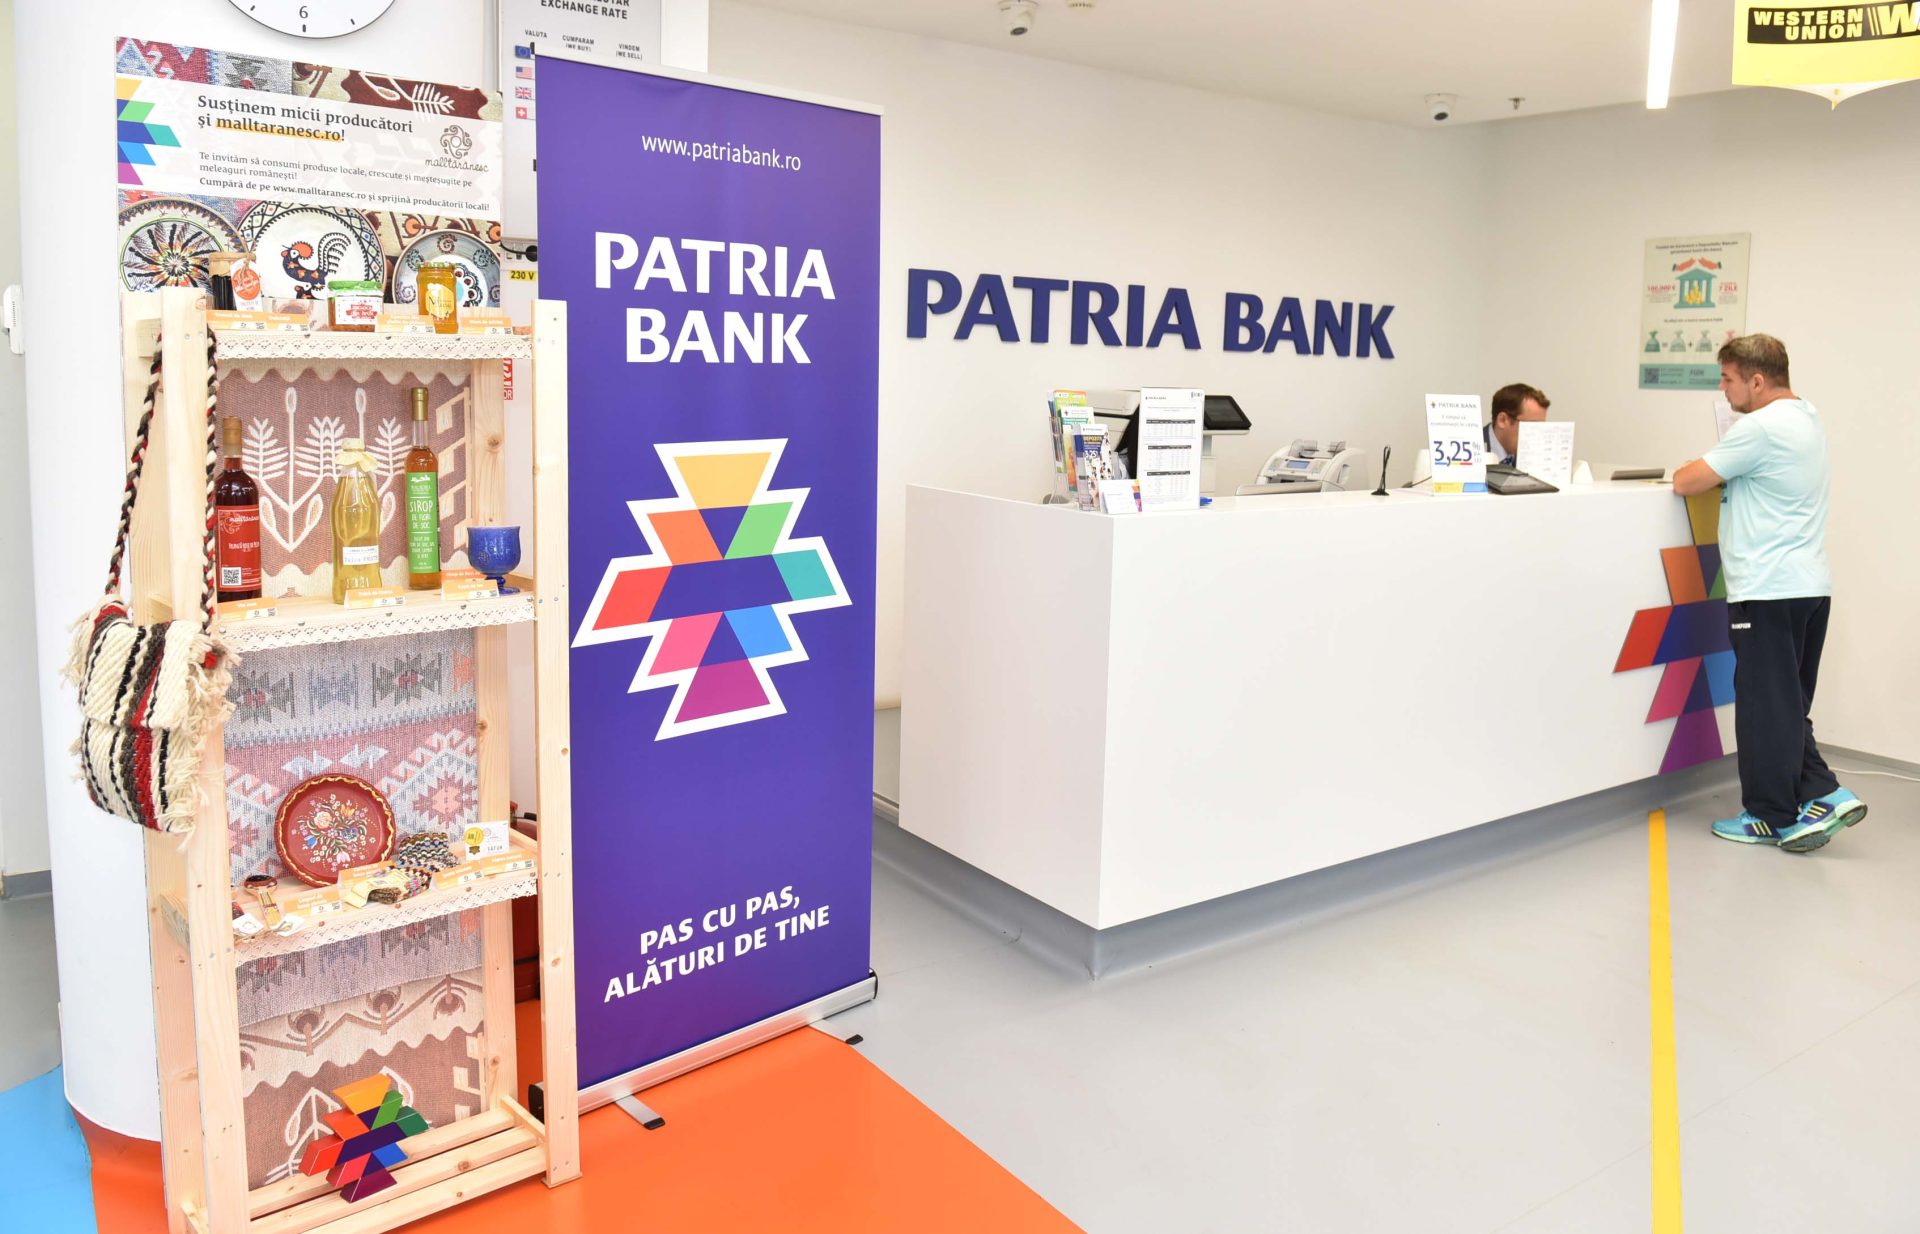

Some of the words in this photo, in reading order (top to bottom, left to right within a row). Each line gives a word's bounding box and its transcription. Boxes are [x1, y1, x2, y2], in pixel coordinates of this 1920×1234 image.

[299, 5, 308, 18] 6
[541, 0, 598, 15] EXCHANGE
[601, 6, 628, 19] RATE
[1753, 7, 1863, 26] WESTERN
[525, 29, 548, 38] VALUTA
[562, 35, 594, 45] CUMPARAM
[1785, 22, 1863, 41] UNION
[618, 43, 640, 52] VINDEM
[216, 117, 345, 141] malltaranesc.ro!
[281, 106, 321, 122] micii
[325, 112, 413, 133] producători
[641, 135, 802, 171] www.patriabank.ro
[199, 163, 247, 175] meleaguri
[212, 153, 248, 164] invităm
[250, 157, 260, 165] să
[262, 160, 301, 170] consumi
[303, 163, 338, 174] produse
[340, 166, 367, 177] locale,
[368, 170, 403, 180] crescute
[462, 180, 473, 190] pe
[199, 177, 244, 188] Cumpără
[245, 181, 257, 189] de
[259, 183, 271, 192] pe
[273, 185, 367, 200] www.malltaranesc.ro
[377, 193, 411, 205] sprijină
[413, 196, 464, 209] producătorii
[465, 202, 490, 211] locali!
[510, 270, 525, 280] 230
[528, 272, 535, 280] V
[595, 231, 836, 300] PATRIA
[906, 268, 1202, 350] PATRIA
[1223, 291, 1395, 359] BANK
[626, 307, 812, 364] BANK
[1433, 441, 1472, 467] 3,25
[409, 499, 434, 512] SIROP
[640, 917, 694, 955] PAS
[702, 903, 736, 933] CU
[746, 885, 800, 920] PAS,
[603, 941, 725, 1003] ALĂTURI
[734, 927, 767, 957] DE
[775, 905, 830, 941] TINE
